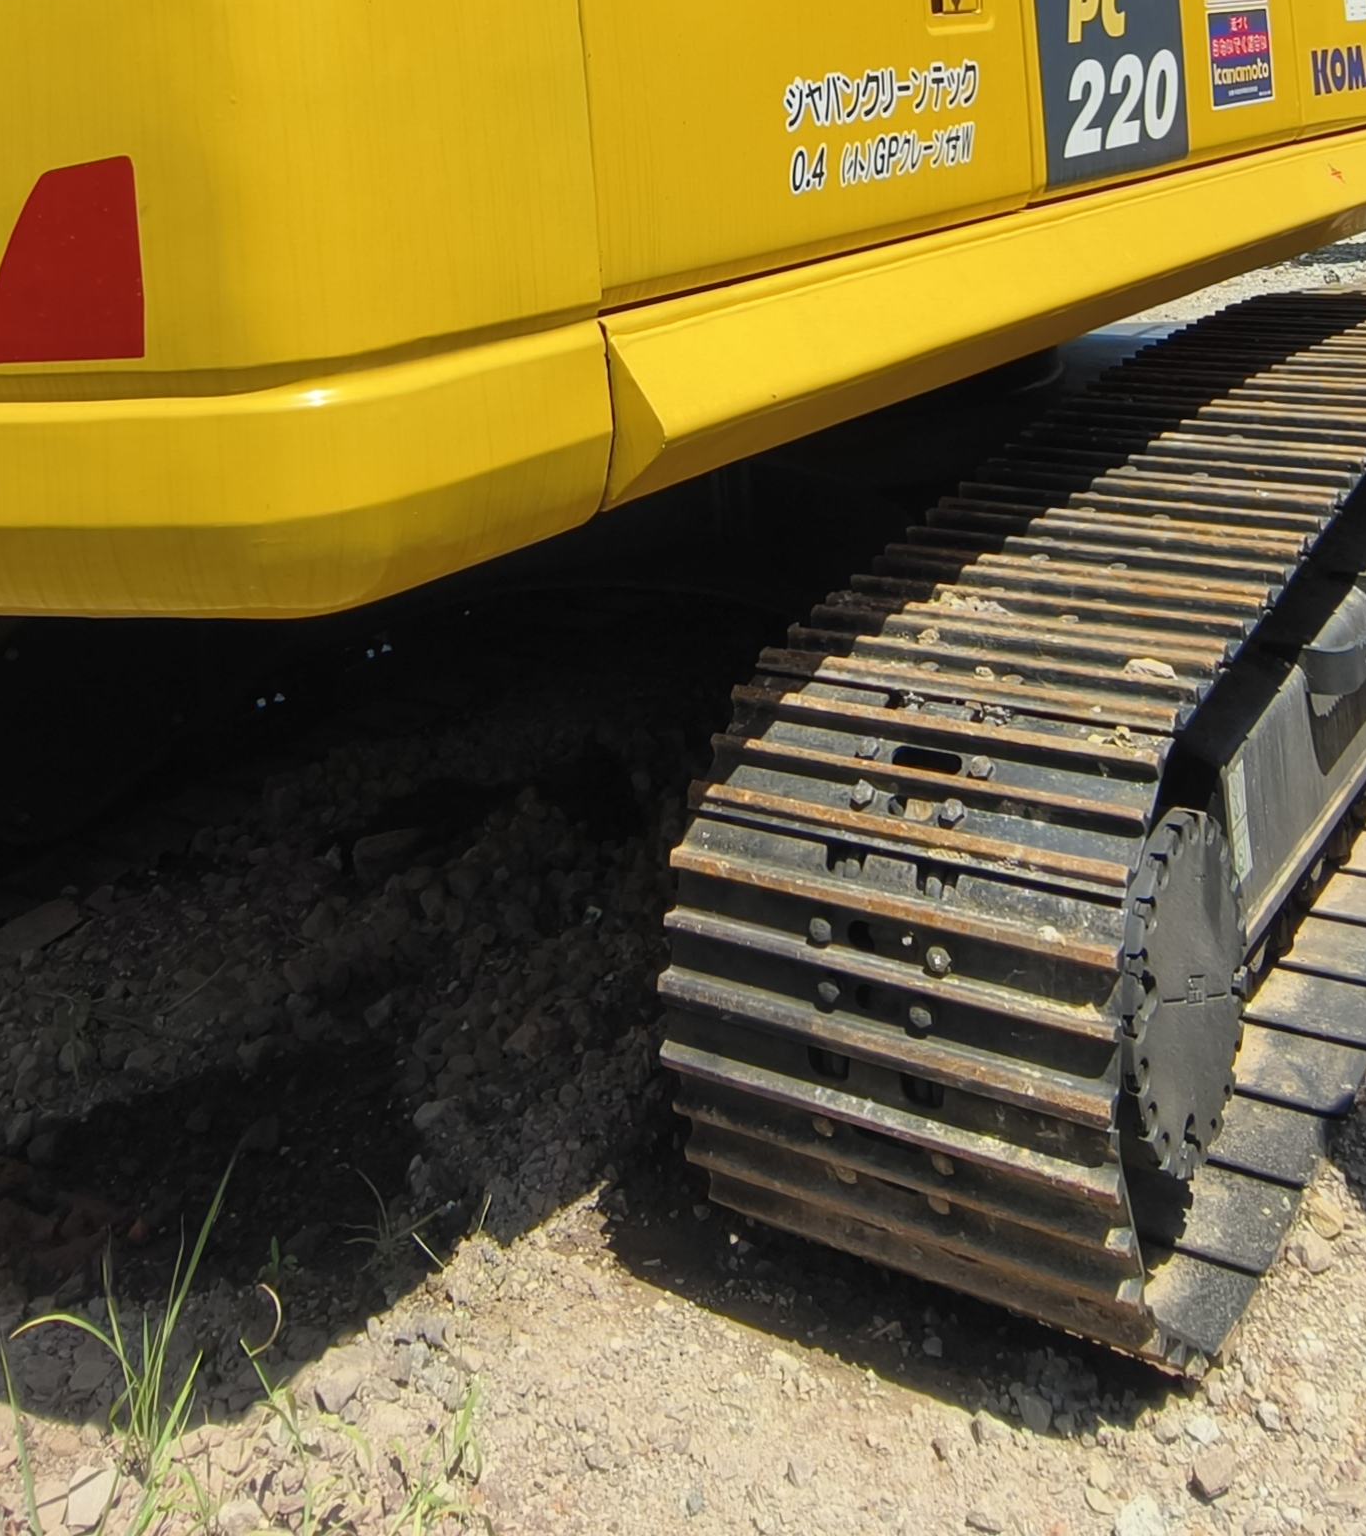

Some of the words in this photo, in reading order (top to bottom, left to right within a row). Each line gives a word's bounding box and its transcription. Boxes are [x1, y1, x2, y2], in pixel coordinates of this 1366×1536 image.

[1213, 57, 1270, 85] kanamoto
[1063, 48, 1179, 159] 220
[791, 146, 825, 192] 0.4
